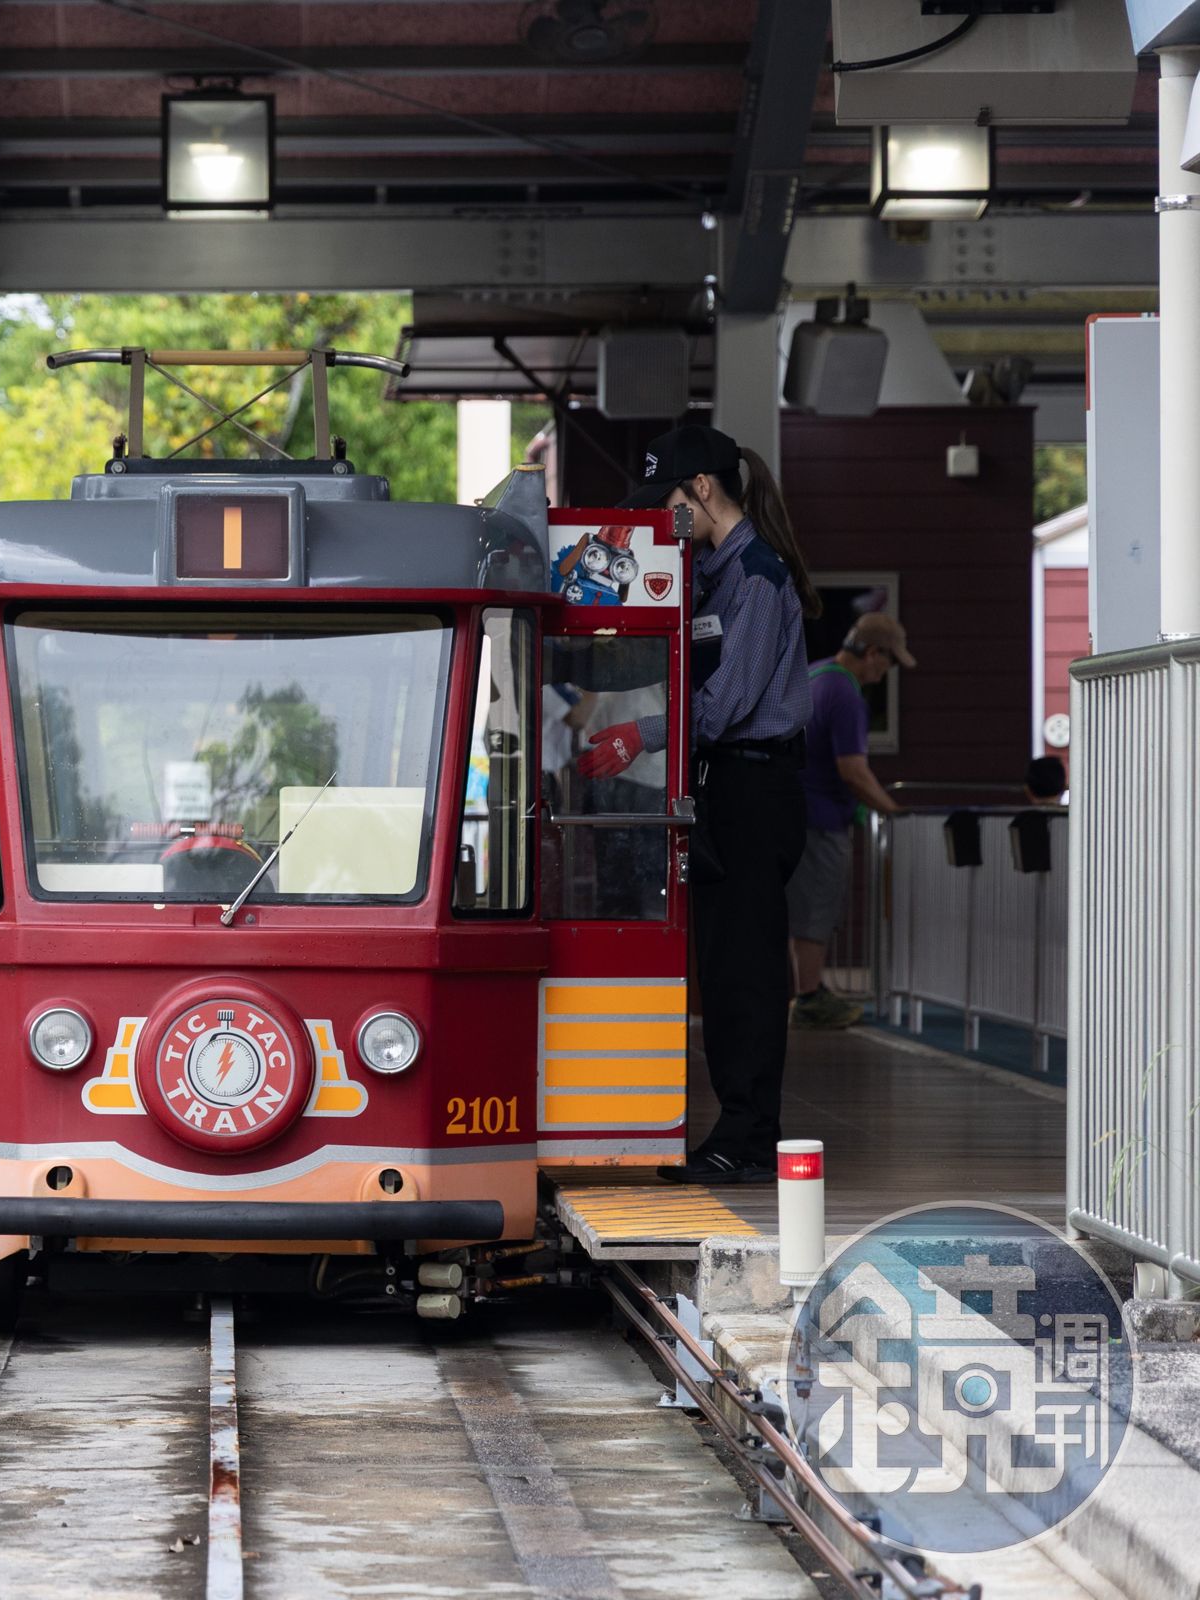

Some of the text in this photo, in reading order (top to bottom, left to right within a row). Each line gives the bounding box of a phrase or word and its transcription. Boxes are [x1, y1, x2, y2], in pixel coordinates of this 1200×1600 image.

[223, 506, 242, 569] 1
[165, 1012, 287, 1069] TIC TAC
[167, 1078, 285, 1133] TRAIN
[446, 1096, 520, 1135] 2101
